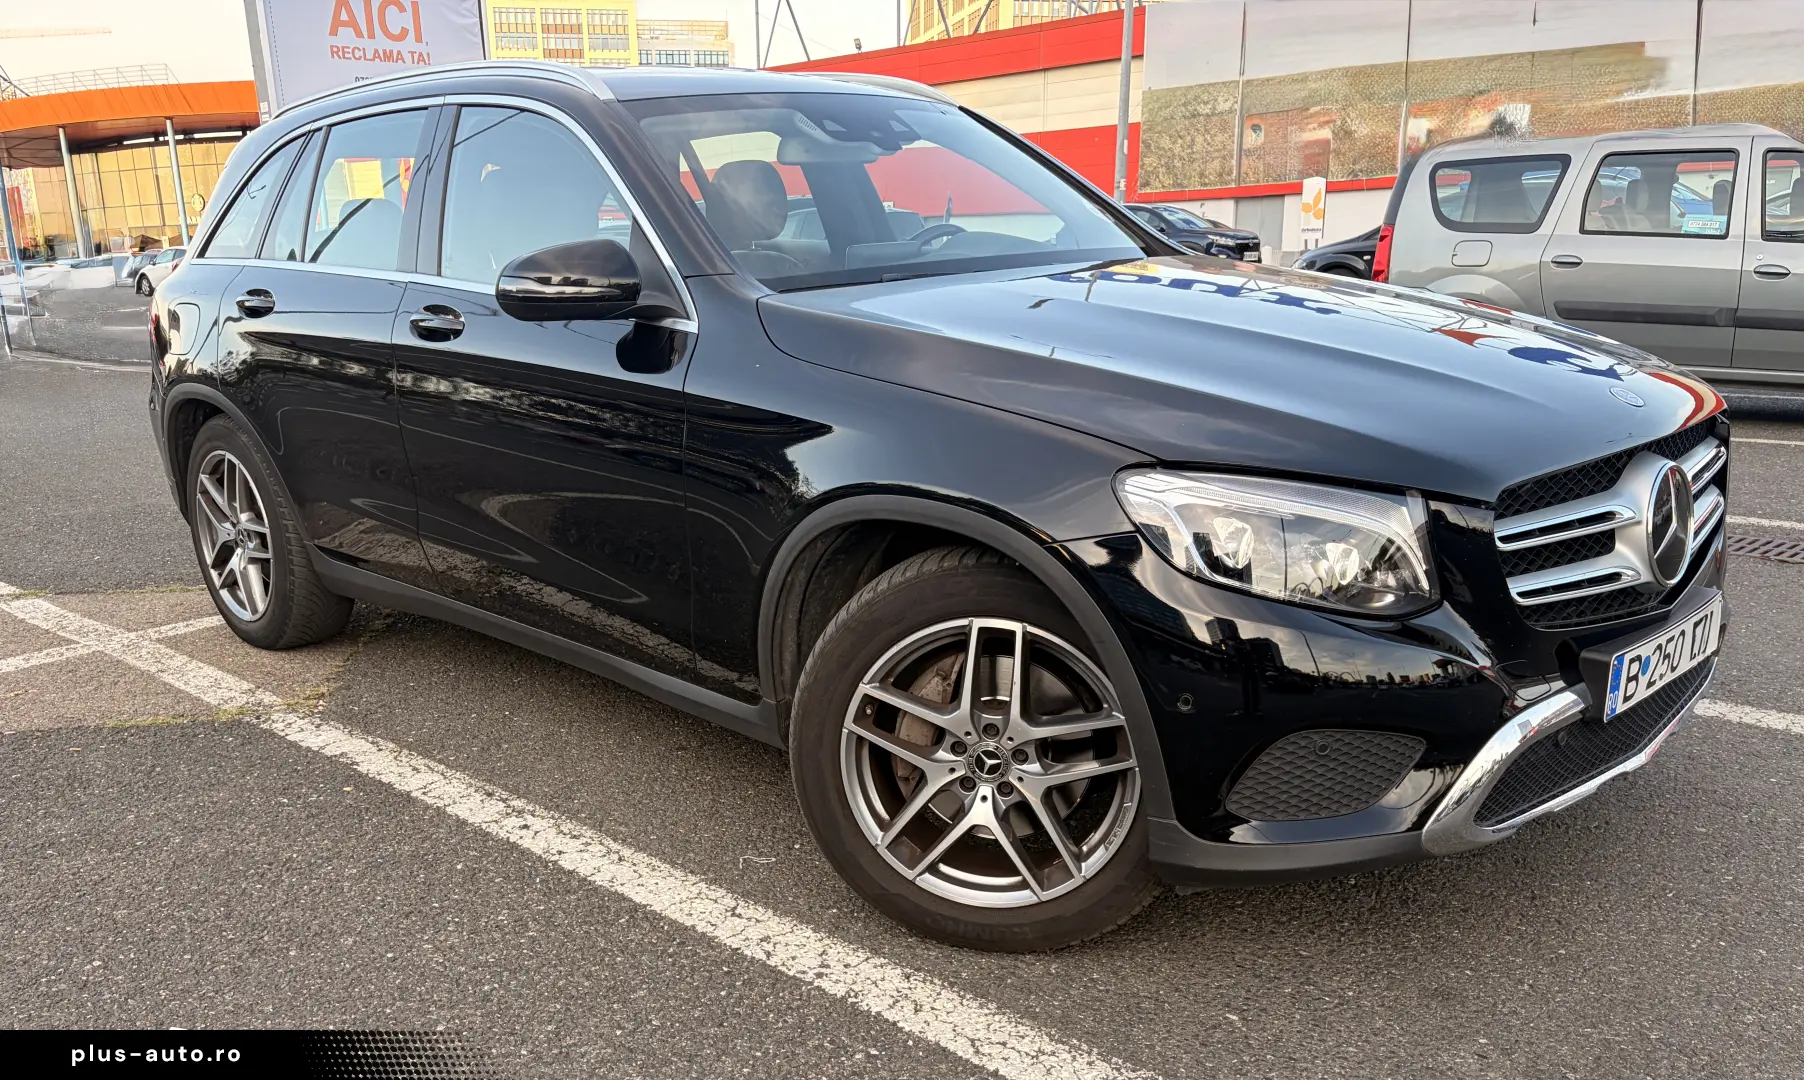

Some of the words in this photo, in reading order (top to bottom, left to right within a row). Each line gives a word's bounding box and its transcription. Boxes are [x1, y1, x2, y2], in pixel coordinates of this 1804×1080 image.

[330, 44, 406, 64] RECLAMA
[408, 51, 431, 65] TA!
[1622, 654, 1642, 705] B
[1645, 629, 1685, 691] 250
